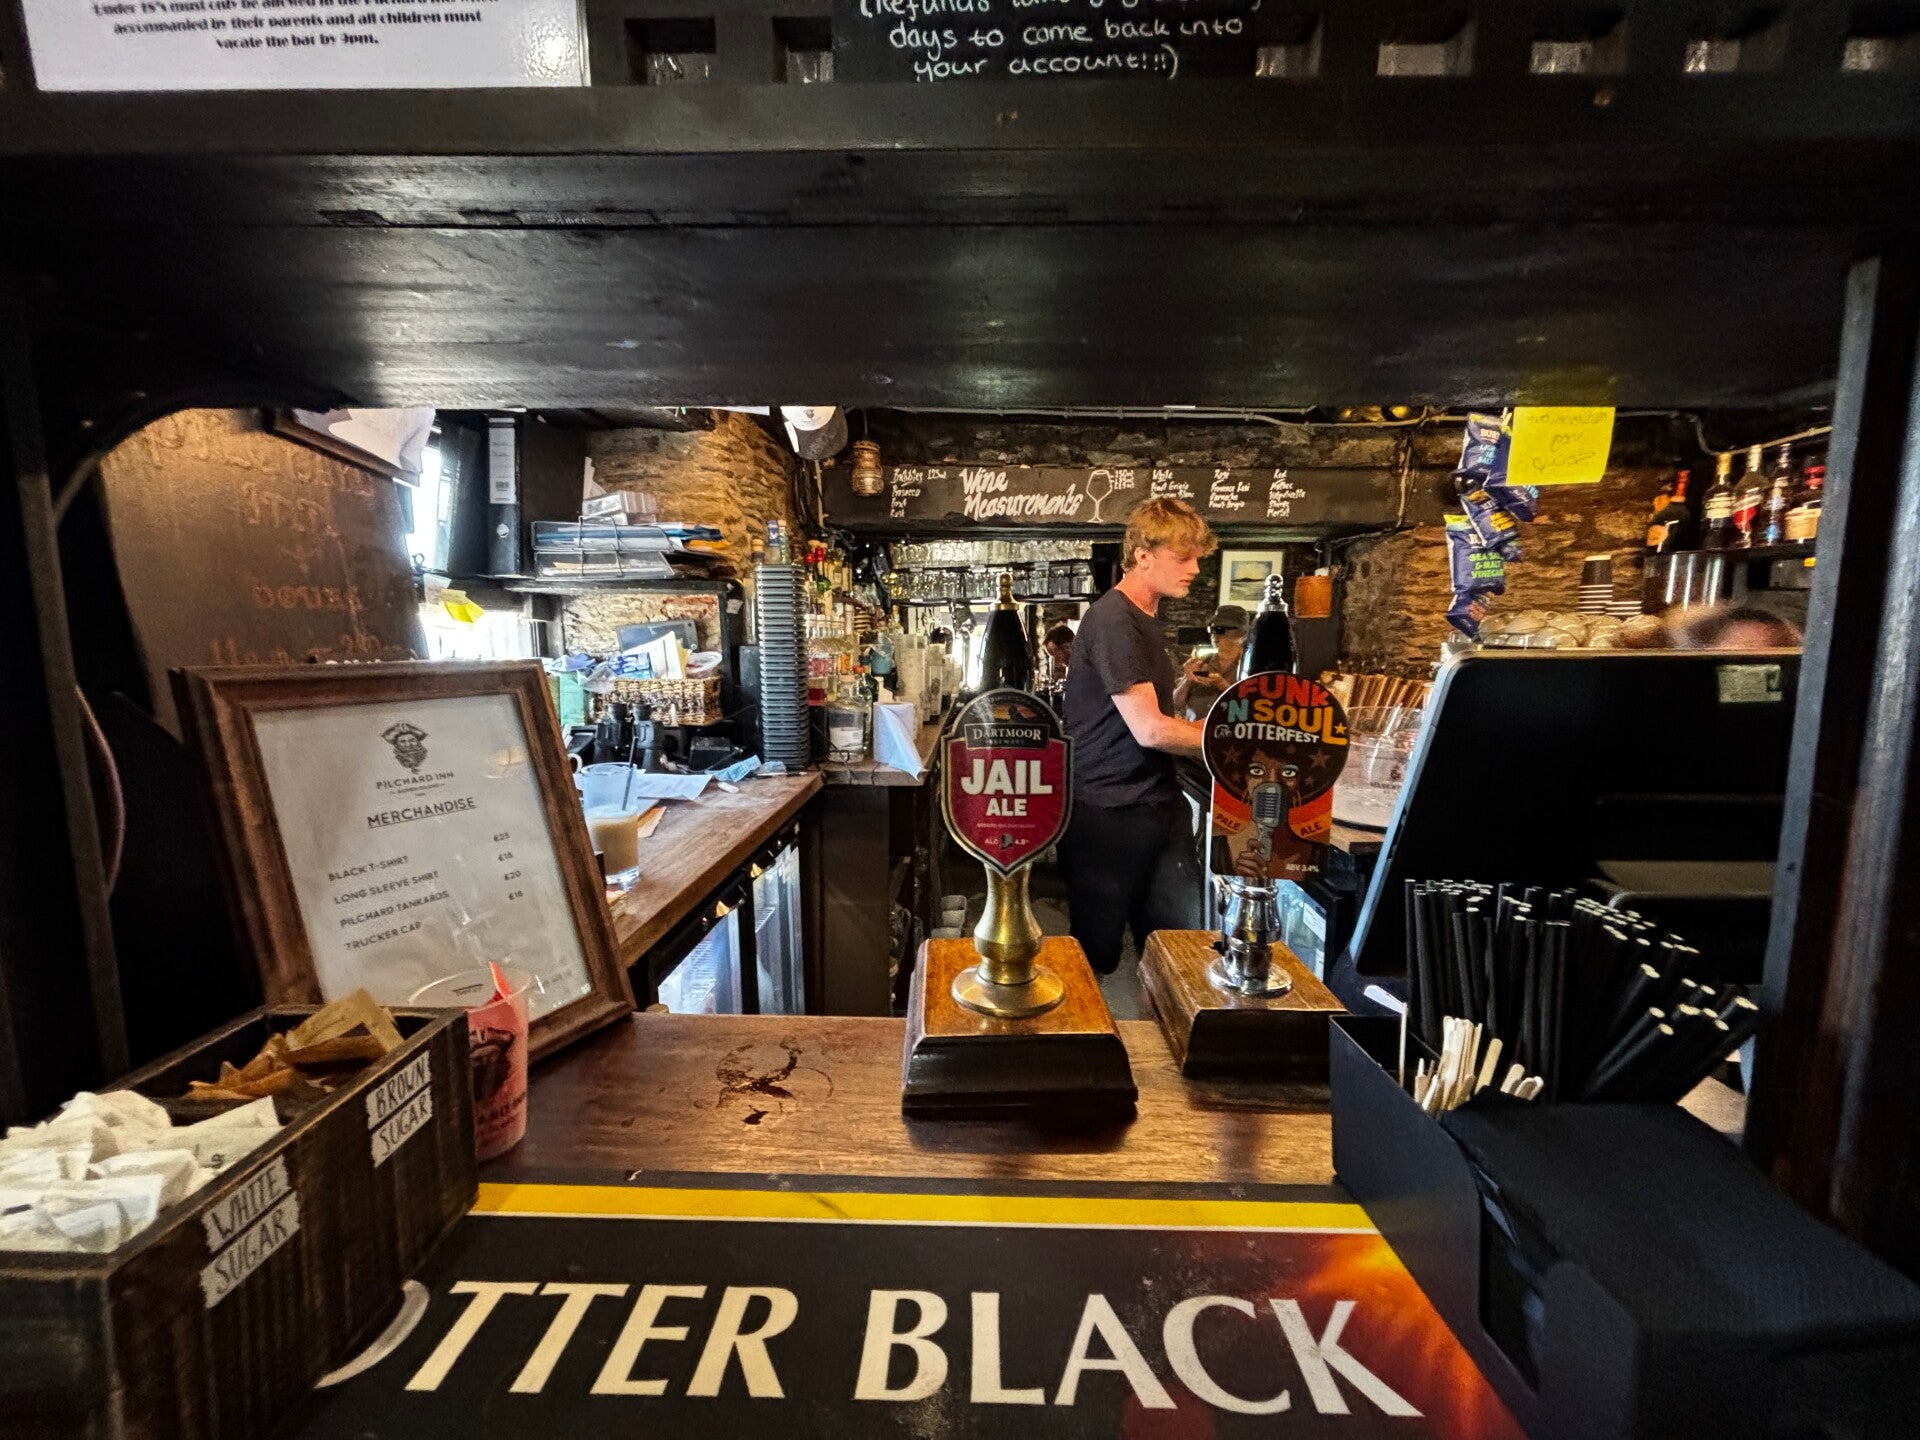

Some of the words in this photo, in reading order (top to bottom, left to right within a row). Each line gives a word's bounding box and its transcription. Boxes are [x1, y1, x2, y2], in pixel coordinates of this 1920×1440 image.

[230, 15, 263, 28] their
[268, 14, 322, 27] parents
[326, 13, 355, 25] and
[358, 12, 377, 24] all
[380, 11, 442, 23] children
[444, 9, 481, 22] must
[216, 35, 262, 48] vacate
[266, 35, 289, 47] the
[291, 33, 315, 46] bar
[320, 33, 335, 45] by
[889, 20, 958, 61] days
[968, 28, 1004, 47] to
[1023, 23, 1093, 45] come
[1104, 18, 1170, 38] back
[1180, 18, 1243, 36] into
[914, 58, 988, 82] your
[959, 467, 1009, 494] Wine
[1168, 481, 1190, 492] Grigio
[1273, 468, 1287, 479] Red
[891, 484, 921, 497] Prosecco
[964, 483, 1083, 520] Measurements
[973, 728, 1041, 741] DARTMOOR
[1234, 722, 1319, 743] OTTERFEST
[1253, 699, 1348, 745] SOUL
[376, 774, 433, 790] PILCHARD
[435, 770, 455, 781] INN
[961, 758, 1053, 796] JAIL
[367, 797, 476, 827] MERCHANDISE
[986, 798, 1028, 817] ALE
[1300, 821, 1323, 836] ALE
[328, 867, 366, 882] BLACK
[368, 855, 409, 872] T-SHIRT
[334, 889, 368, 905] LONG
[369, 879, 410, 896] SLEEVE
[412, 870, 439, 885] SHIRT
[340, 906, 394, 928] PILCHARD
[396, 890, 450, 912] TANKARDS
[344, 927, 399, 950] TRUCKER
[400, 921, 422, 935] CAP
[376, 1056, 426, 1119] BROWN
[380, 1093, 427, 1157] SUGAR
[211, 1165, 282, 1239] WHITE
[214, 1208, 288, 1295] SUGAR
[316, 1280, 799, 1399] TTER
[853, 1289, 1426, 1417] BLACK
